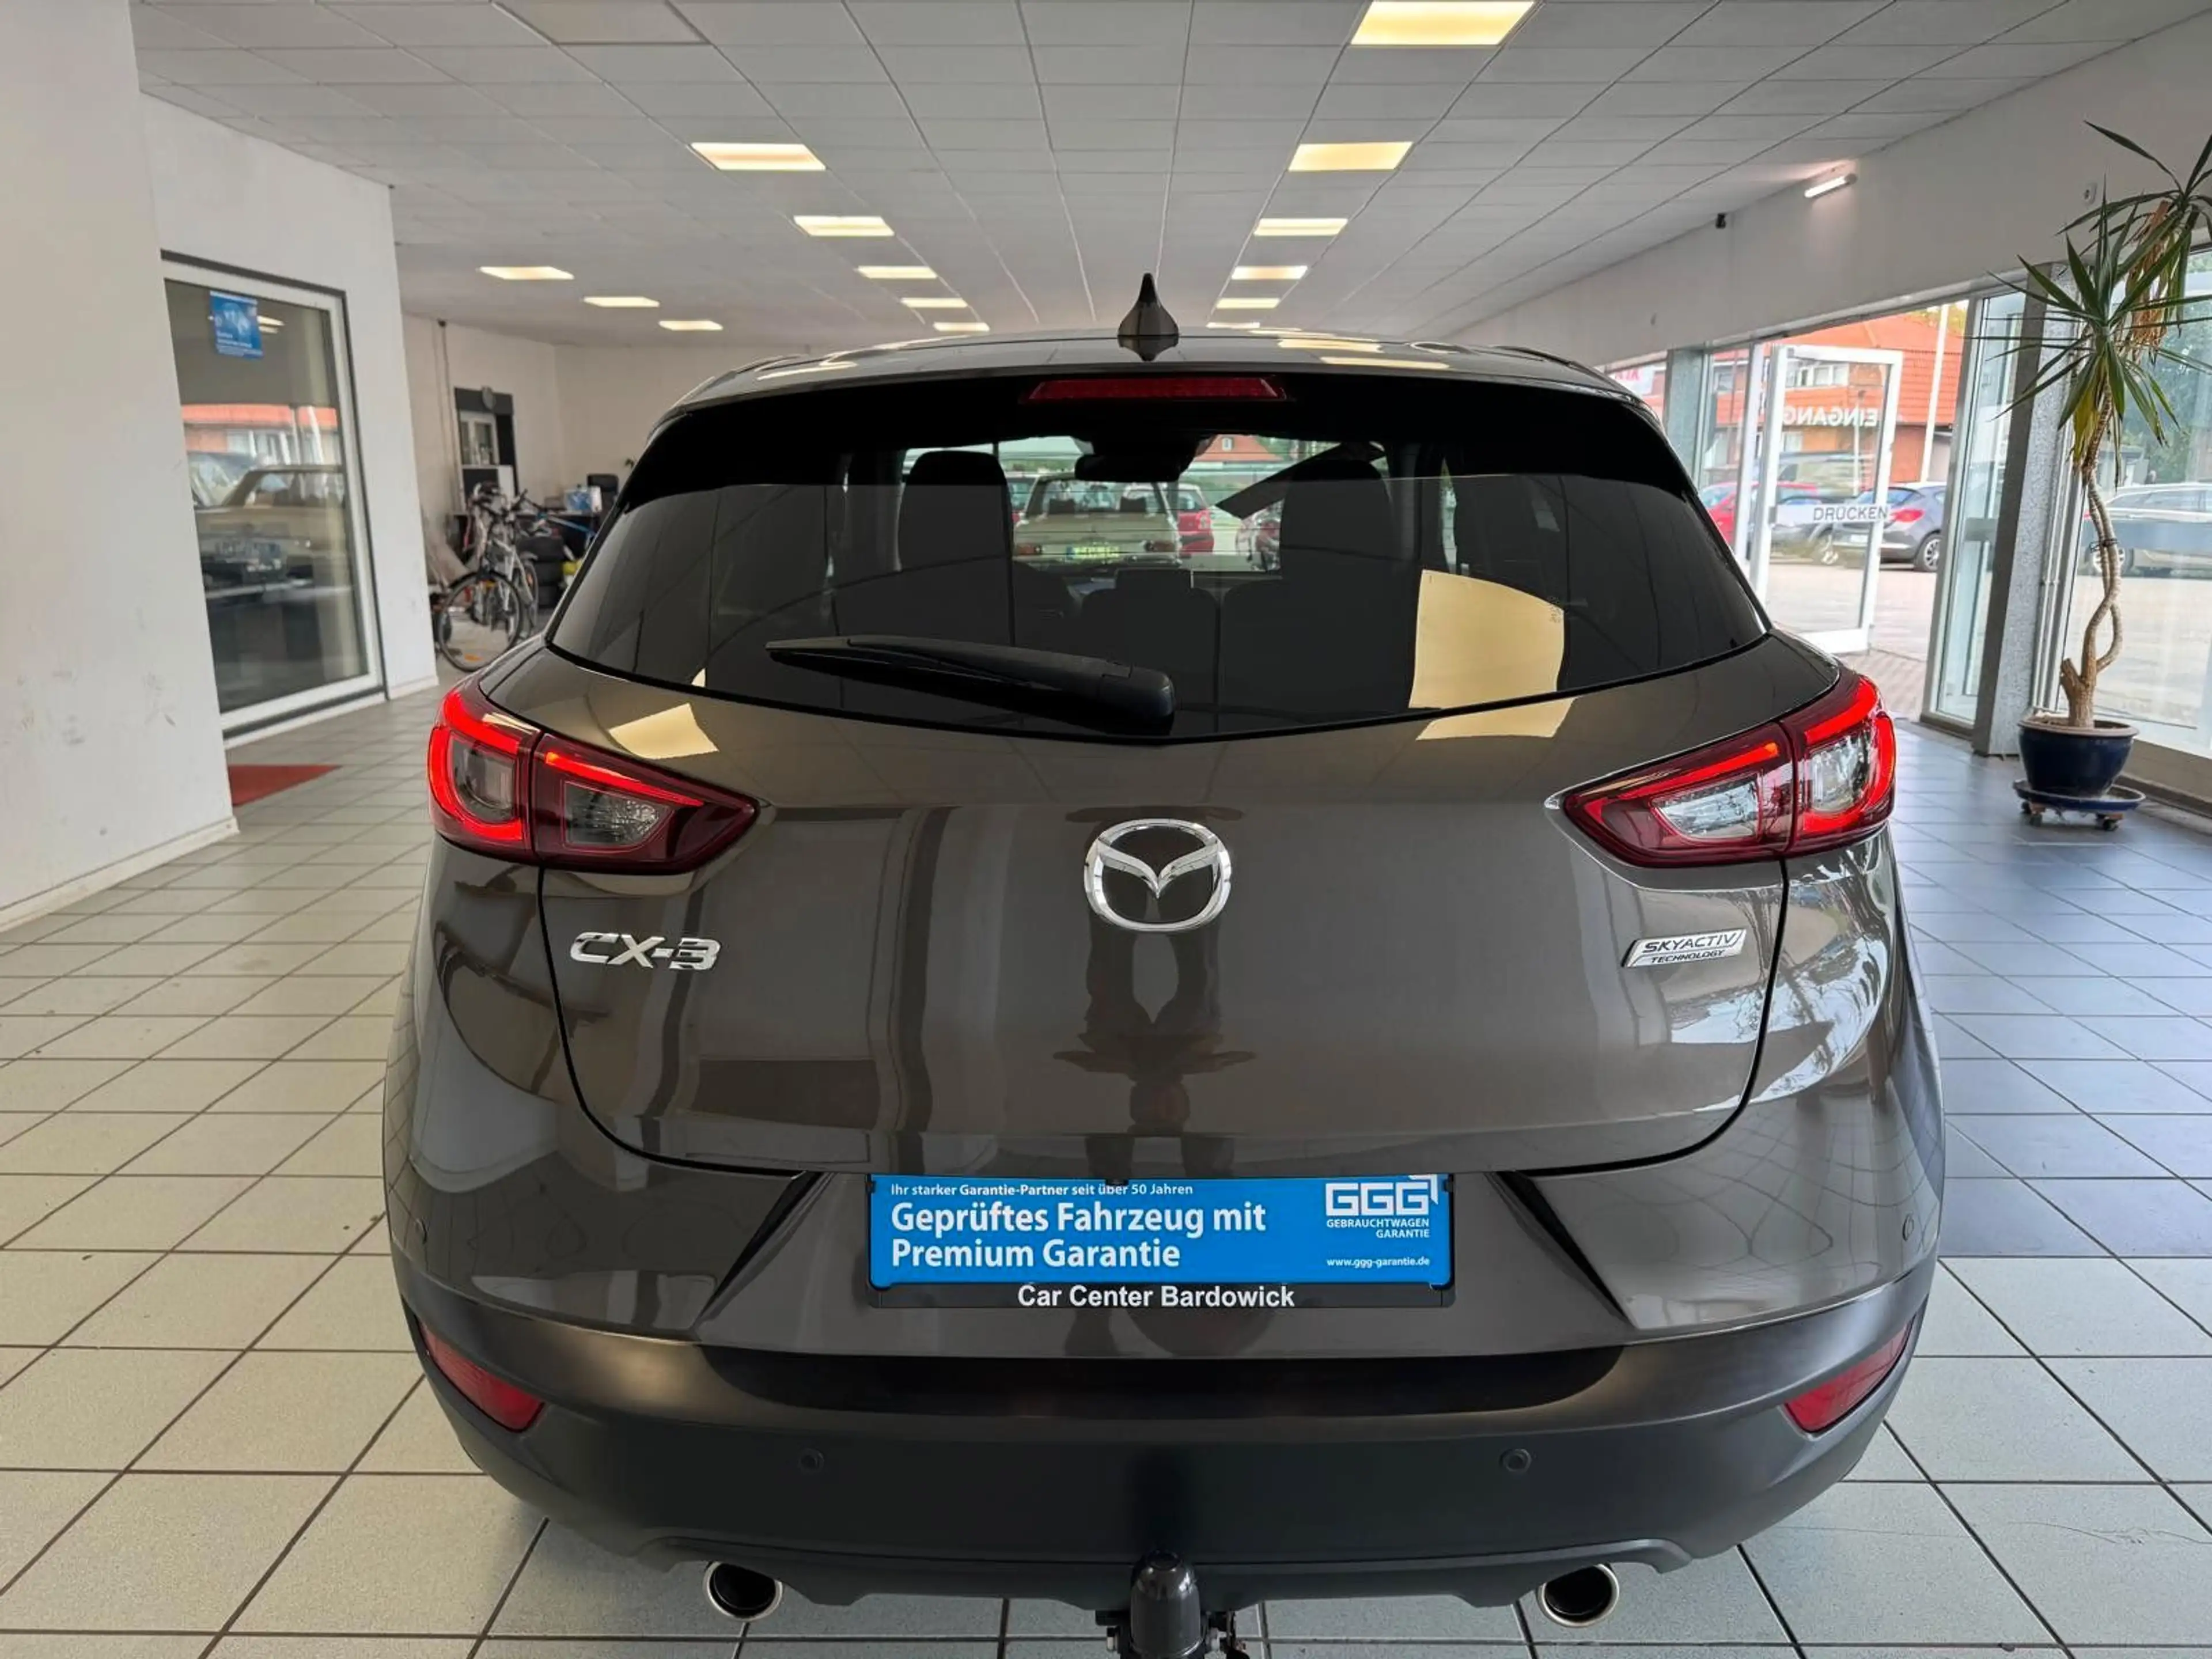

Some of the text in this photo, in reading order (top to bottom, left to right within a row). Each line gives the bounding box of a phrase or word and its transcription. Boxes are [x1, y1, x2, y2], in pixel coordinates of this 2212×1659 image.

[1813, 505, 1888, 521] DRÜCKEN
[570, 931, 721, 970] CX-3
[1642, 933, 1736, 953] SKYACTIV
[1652, 949, 1725, 963] TECHNOLOGY
[891, 1183, 1193, 1195] Ihr starker Garantie-Partner seit über 50 Jahren
[1326, 1183, 1429, 1216] GGG
[892, 1200, 1266, 1238] Geprüftes Fahrzeug mit
[1327, 1218, 1429, 1228] GEBRAUCHTWAGEN
[1376, 1229, 1430, 1238] GARANTIE
[892, 1238, 1180, 1267] Premium Garantie
[1327, 1256, 1430, 1268] www.ggg-garantie.de
[1017, 1285, 1295, 1307] Car Center Bardowick
